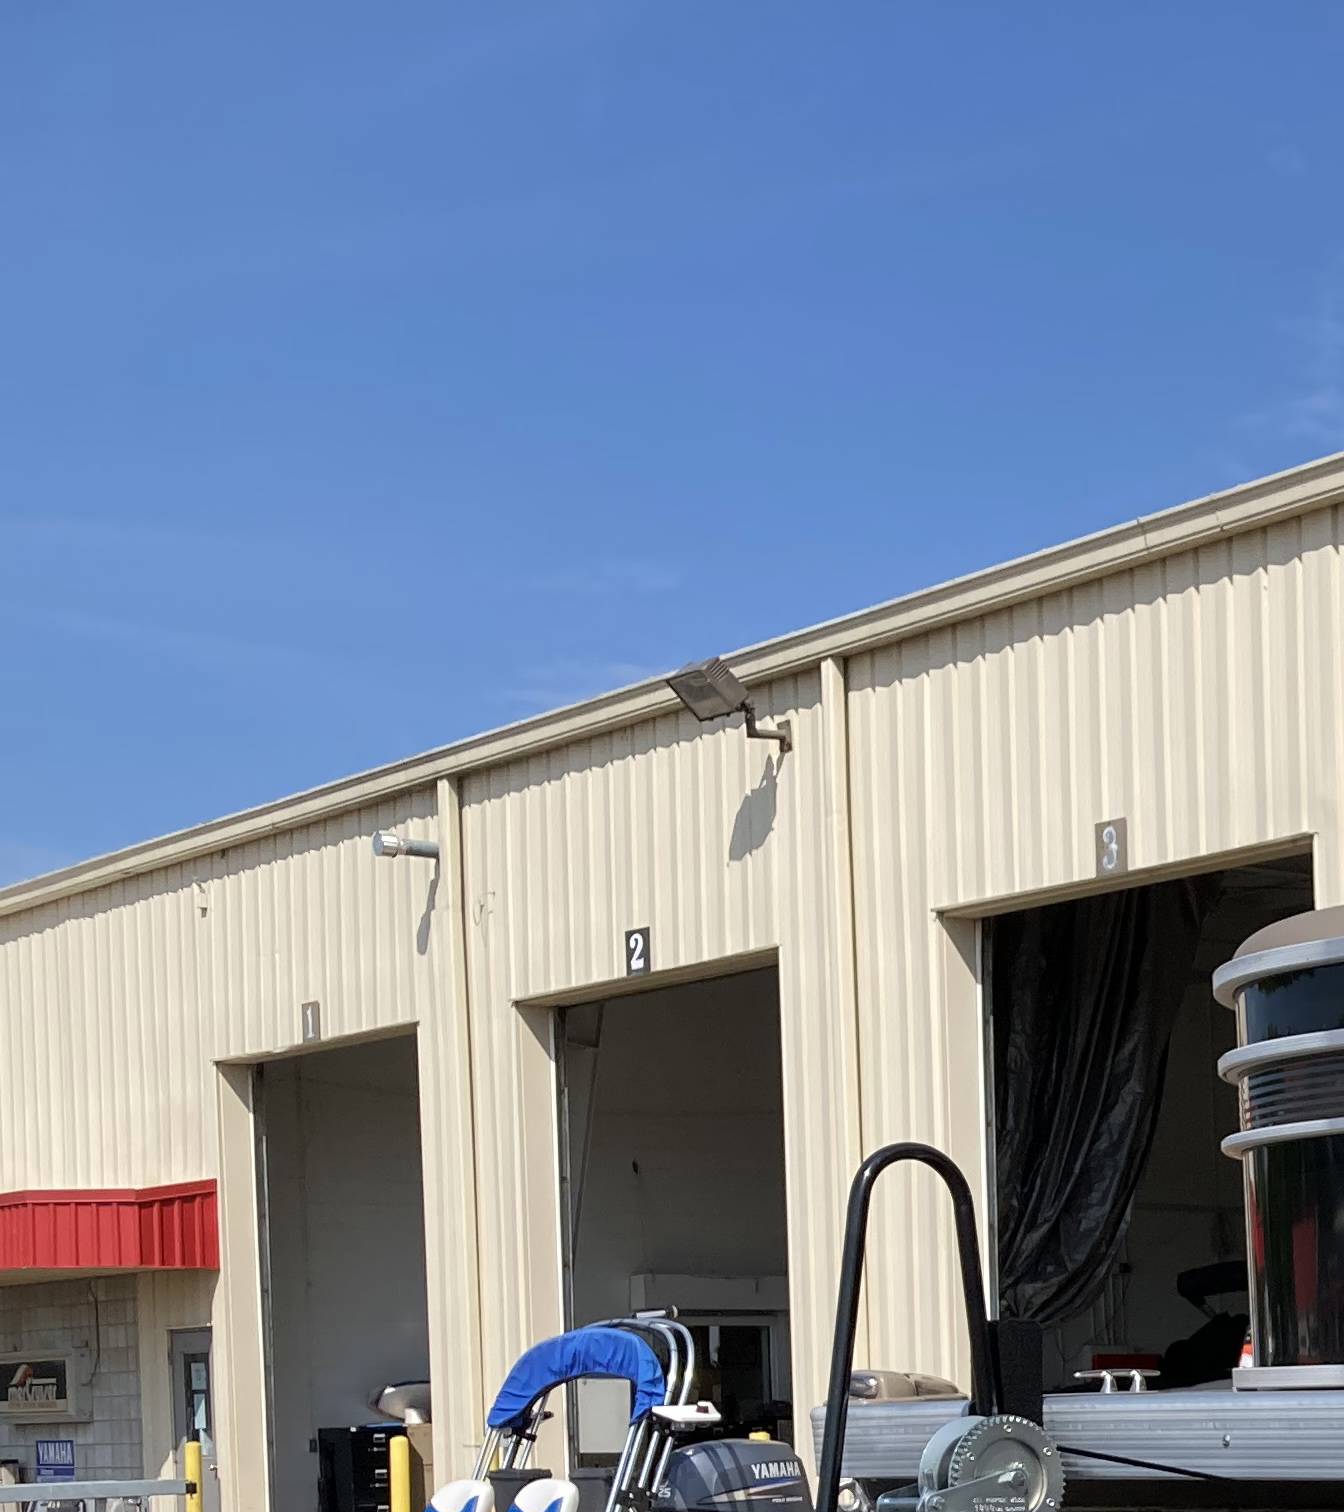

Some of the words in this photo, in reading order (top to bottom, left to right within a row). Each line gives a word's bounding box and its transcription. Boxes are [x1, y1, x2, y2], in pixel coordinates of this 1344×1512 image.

[1103, 826, 1118, 869] 3
[630, 933, 644, 970] 2
[38, 1442, 73, 1465] YAMAHA
[751, 1461, 801, 1480] YAMAHA
